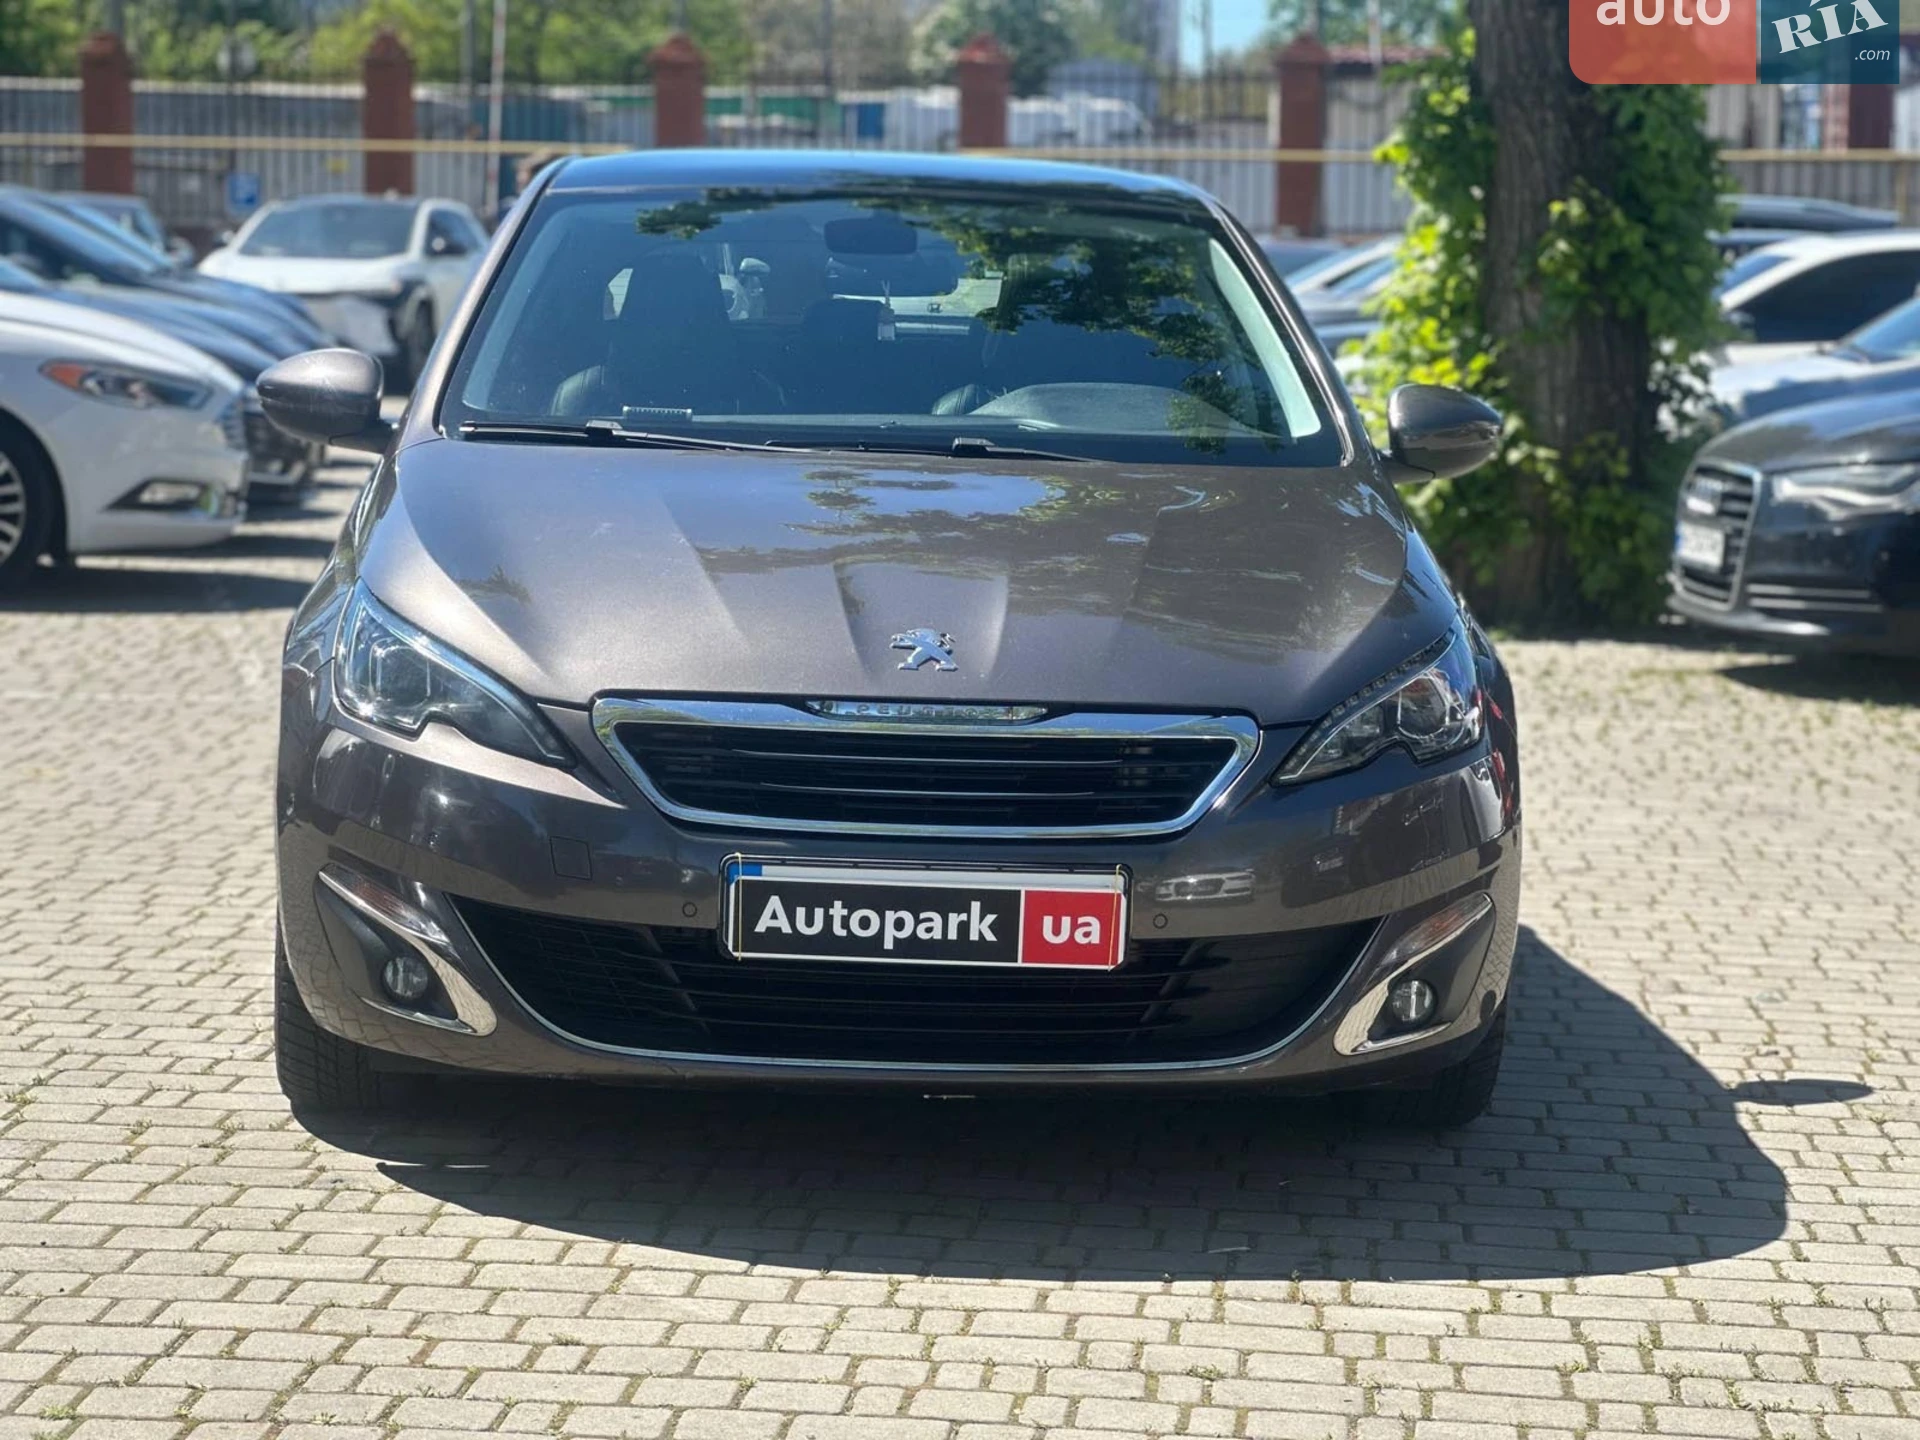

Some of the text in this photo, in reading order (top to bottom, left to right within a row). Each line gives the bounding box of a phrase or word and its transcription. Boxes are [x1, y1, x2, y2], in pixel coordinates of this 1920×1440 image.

[856, 703, 999, 720] PEUGO
[754, 894, 1101, 950] Autopark ua
